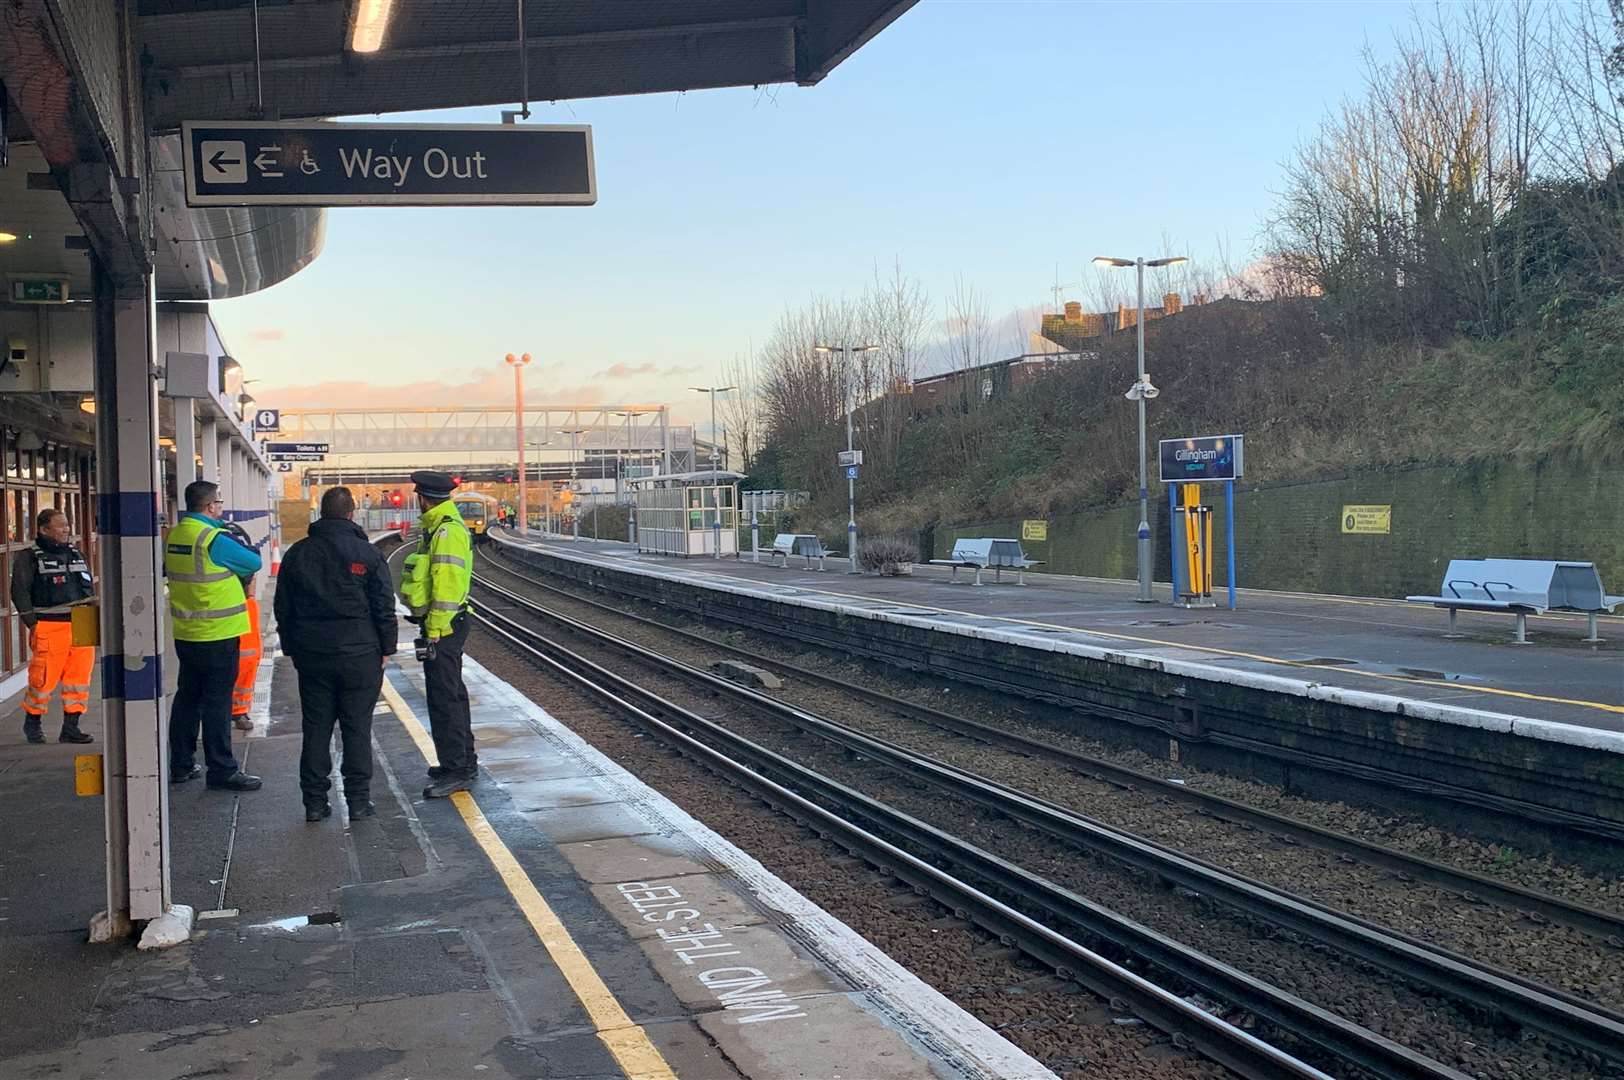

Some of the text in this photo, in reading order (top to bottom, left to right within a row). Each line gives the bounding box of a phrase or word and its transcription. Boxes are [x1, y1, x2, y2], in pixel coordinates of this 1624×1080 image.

[339, 147, 488, 187] Way Out
[1175, 448, 1216, 463] Gillingham
[616, 882, 808, 1024] MIND THE STEP
